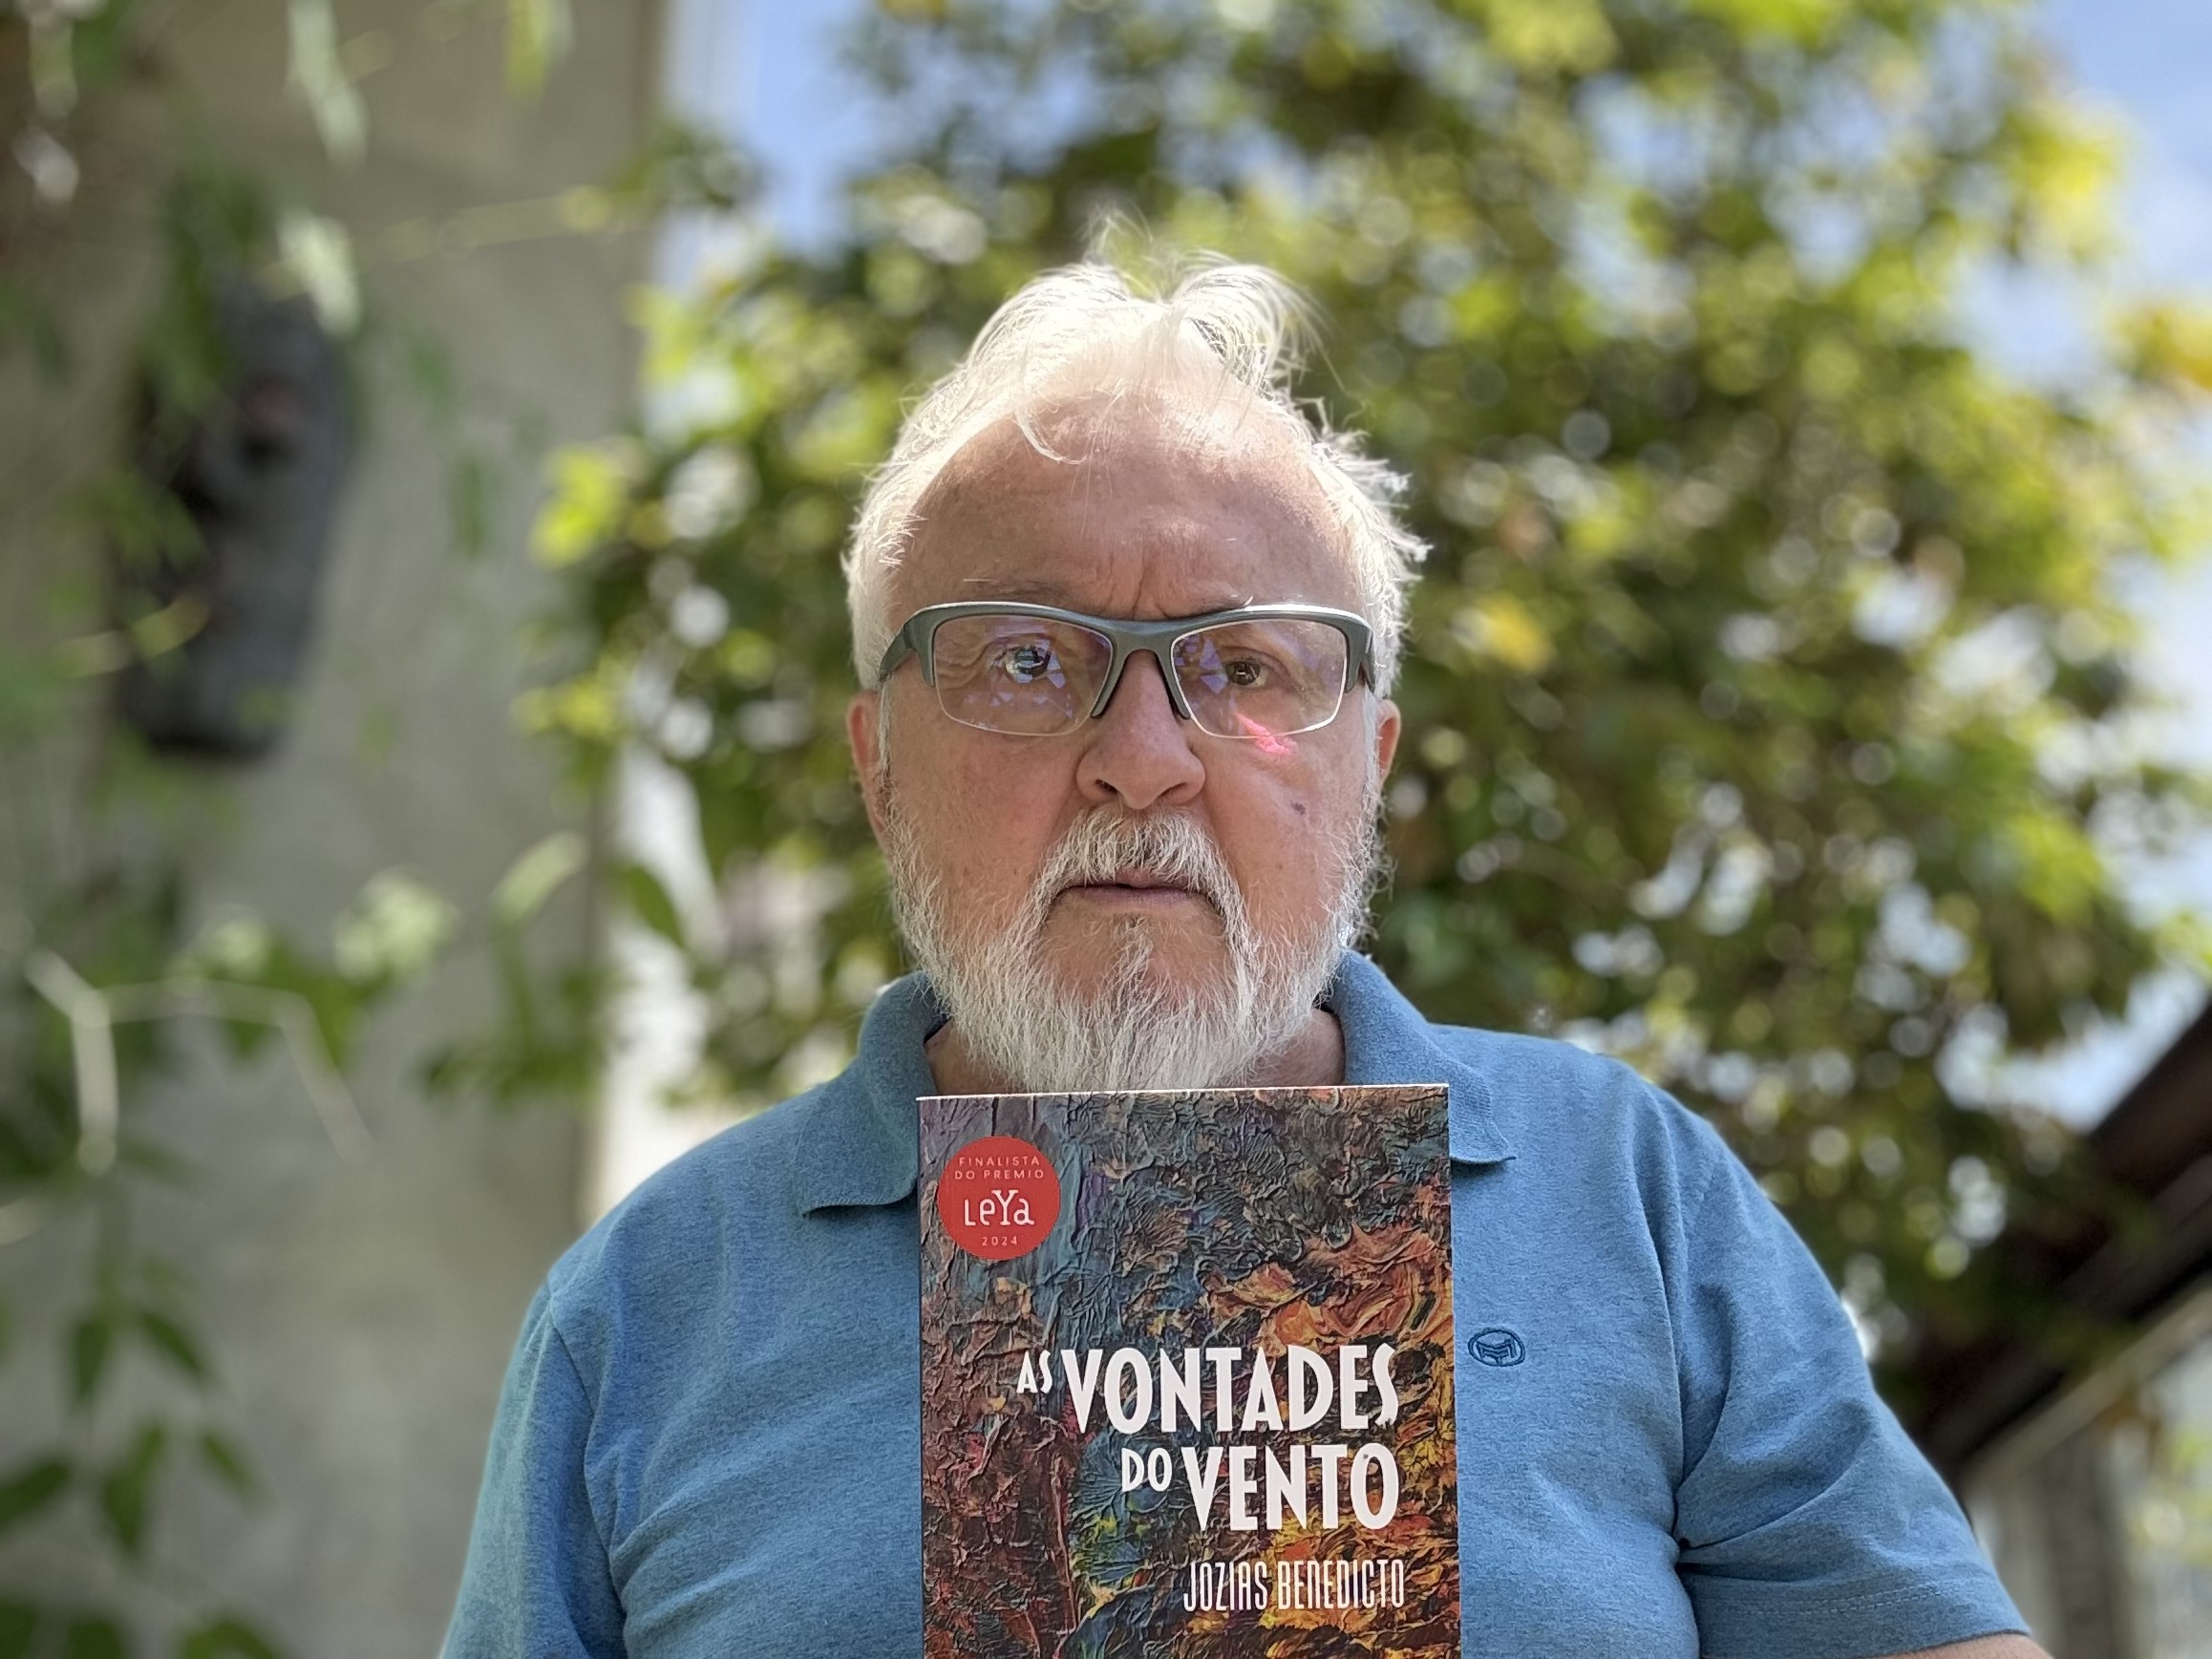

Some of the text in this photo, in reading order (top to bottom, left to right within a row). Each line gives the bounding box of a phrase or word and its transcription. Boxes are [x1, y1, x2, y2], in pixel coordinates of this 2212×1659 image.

[954, 1170, 975, 1180] DO
[958, 1156, 1040, 1167] FINALISTA
[981, 1236, 1018, 1246] 2024
[1016, 1344, 1399, 1434] AS VONTADES
[1121, 1443, 1399, 1530] DO VENTO
[1183, 1559, 1405, 1611] JOZIAS BENEDICTO
